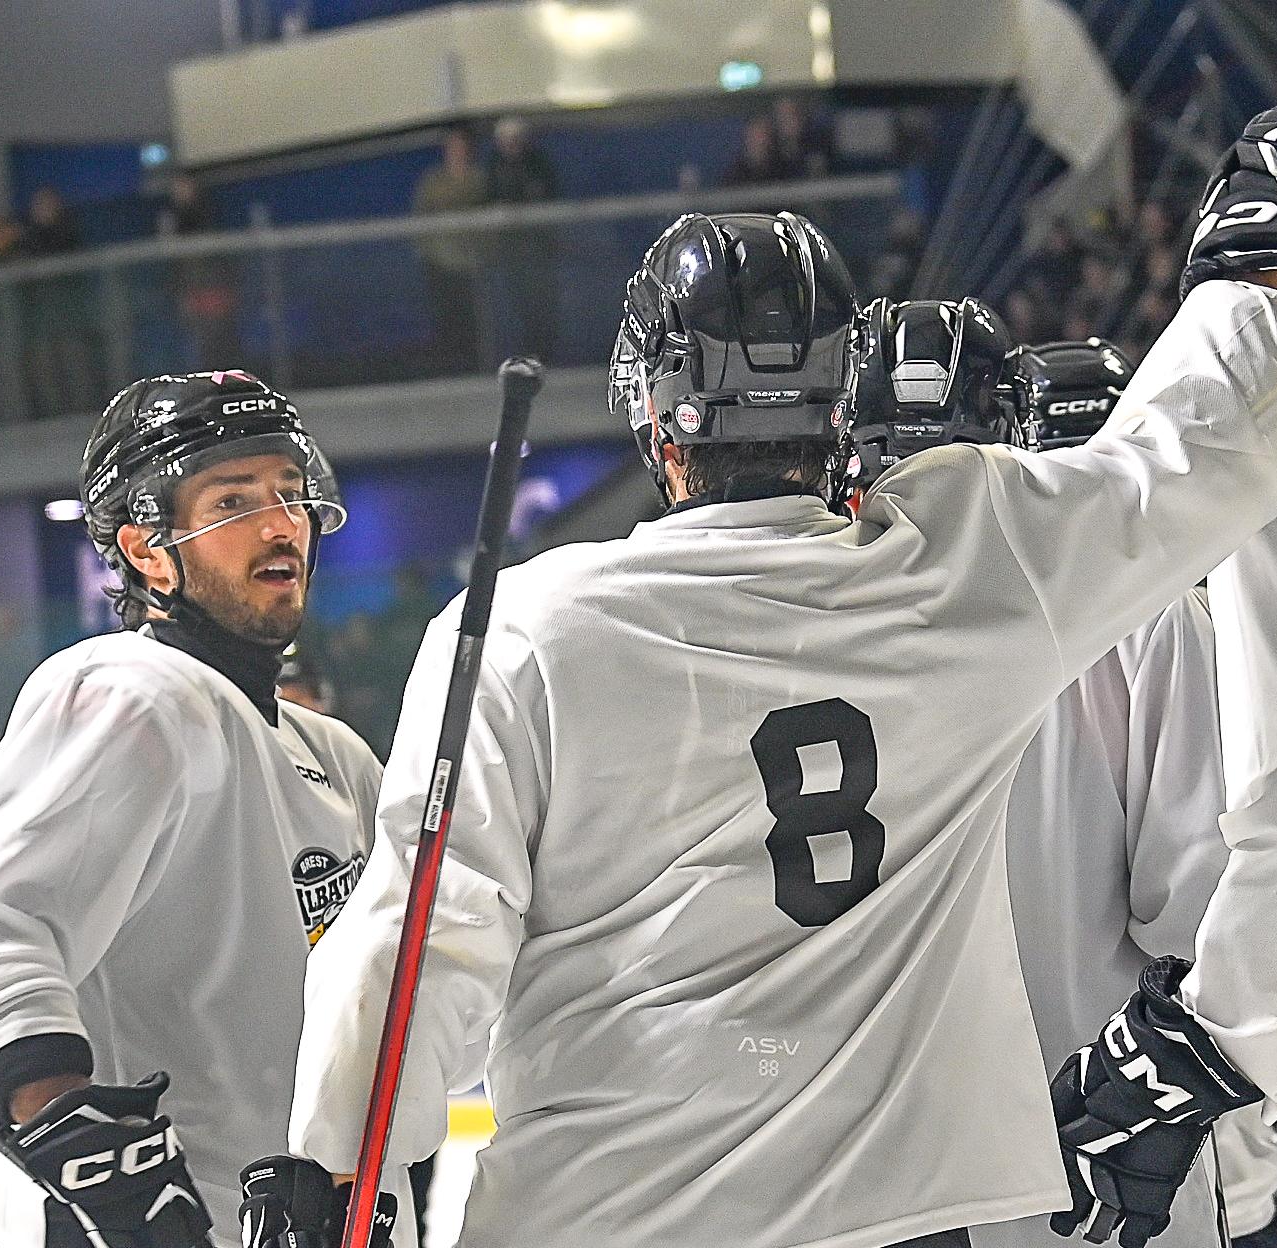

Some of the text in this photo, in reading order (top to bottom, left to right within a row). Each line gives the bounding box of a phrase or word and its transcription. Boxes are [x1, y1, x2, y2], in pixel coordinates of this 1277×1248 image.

[222, 398, 277, 415] CCM
[1047, 398, 1110, 416] CCM
[88, 464, 119, 503] CCM
[295, 764, 332, 789] CCM
[749, 696, 886, 928] 8
[299, 854, 329, 876] BREST
[758, 1059, 779, 1077] 88
